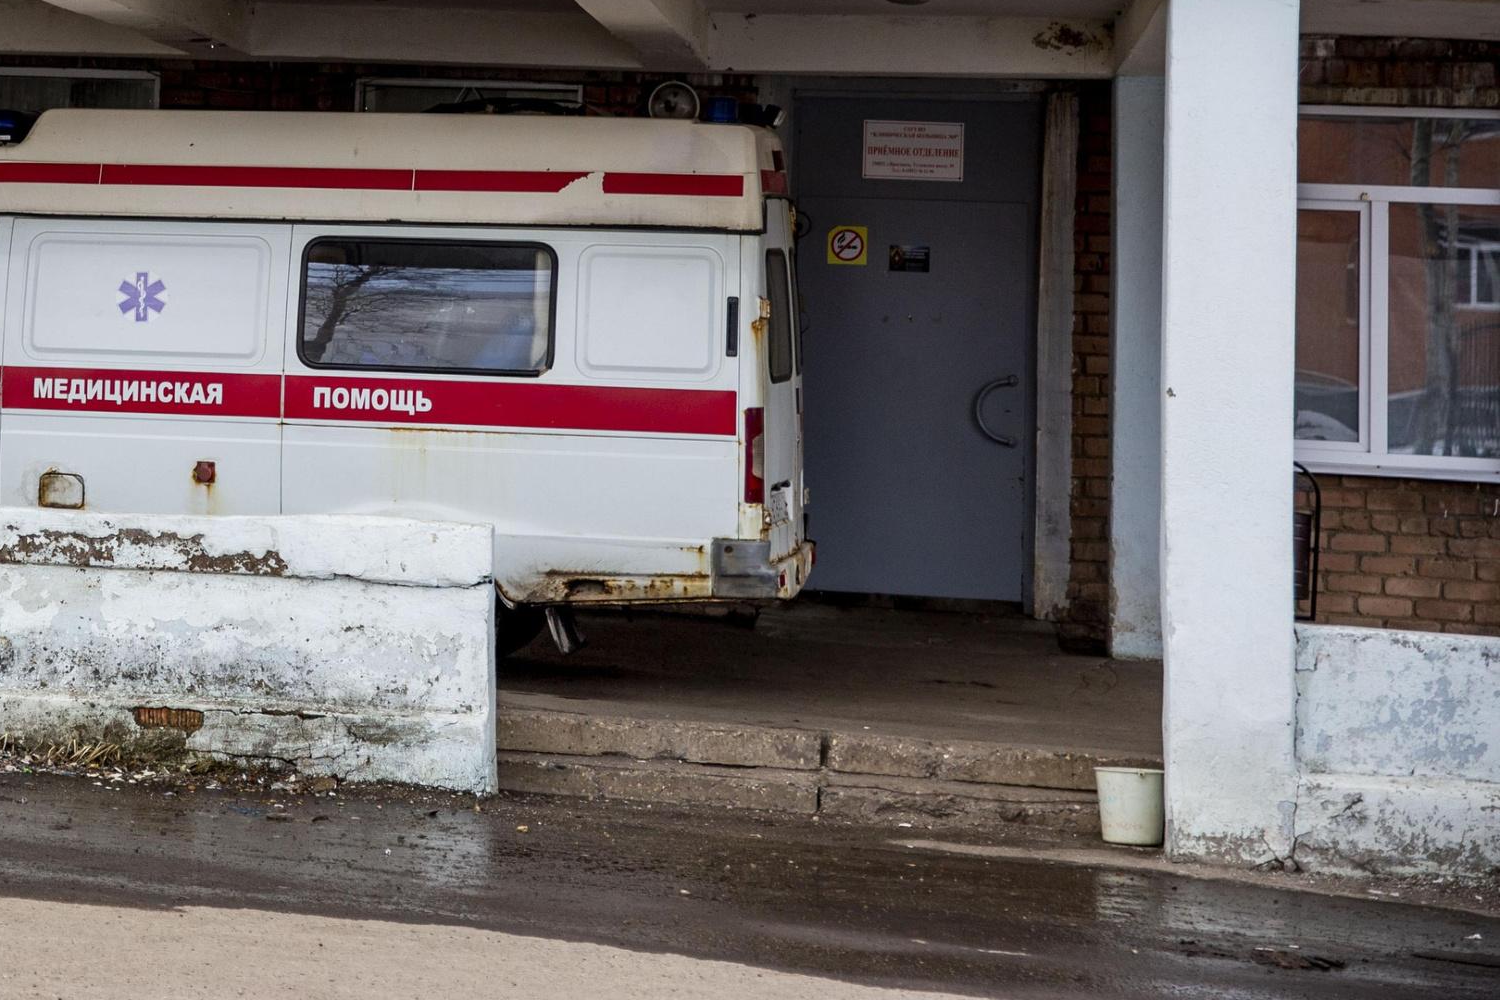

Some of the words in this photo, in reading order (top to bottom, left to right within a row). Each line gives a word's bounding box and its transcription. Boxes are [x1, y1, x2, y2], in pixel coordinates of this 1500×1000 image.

[867, 145, 911, 157] ПРИЁМНОЕ
[912, 147, 960, 158] ОТДЕЛЕНИЕ
[33, 377, 223, 405] МЕДИЦИНСКАЯ
[313, 387, 433, 416] ПОМОЩЬ
